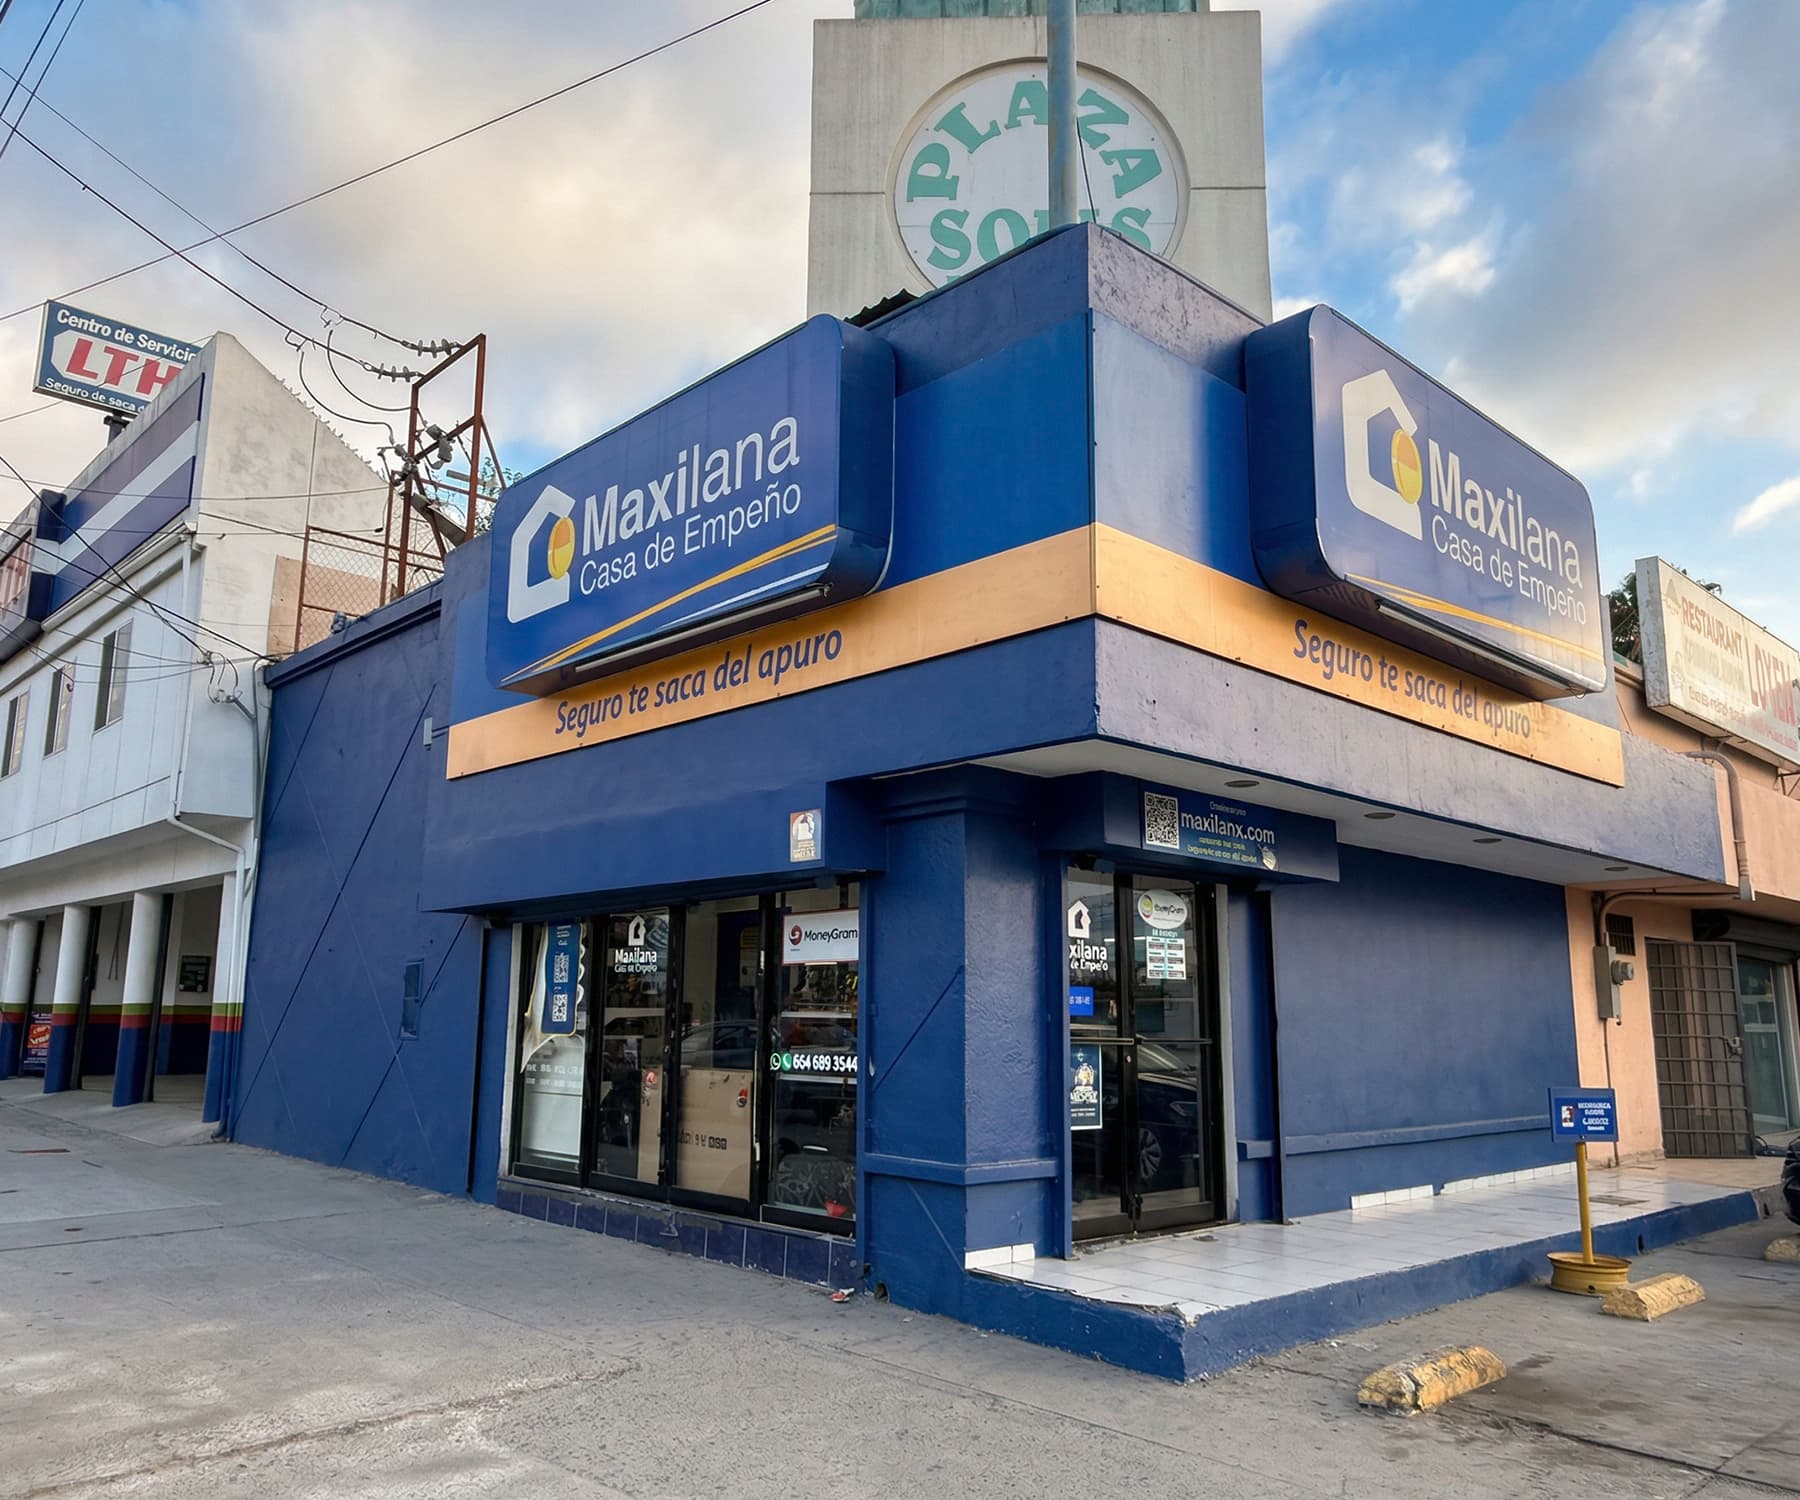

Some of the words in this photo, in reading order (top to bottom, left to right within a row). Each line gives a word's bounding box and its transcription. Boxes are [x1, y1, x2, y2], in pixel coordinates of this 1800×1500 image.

[906, 80, 1162, 202] PLAZA
[927, 207, 1152, 270] SOS
[57, 309, 111, 337] Centro
[114, 327, 135, 344] de
[66, 337, 182, 396] LTH
[45, 377, 89, 399] Seguro
[91, 390, 106, 403] de
[108, 397, 135, 412] saca
[582, 416, 800, 556] Maxilana
[1427, 438, 1584, 589] Maxilana
[579, 554, 637, 596] Casa
[644, 531, 675, 575] de
[684, 481, 802, 555] Empeño
[1431, 514, 1485, 575] Casa
[1489, 547, 1513, 588] de
[1519, 560, 1587, 626] Empeño
[1681, 596, 1743, 660] RESTAURANT
[555, 692, 622, 738] Seguro
[628, 683, 649, 713] te
[654, 667, 705, 708] saca
[713, 643, 752, 690] del
[758, 629, 843, 686] apuro
[1293, 618, 1374, 682] Seguro
[1378, 655, 1398, 691] te
[1404, 669, 1447, 710] saca
[1452, 687, 1478, 721] del
[1483, 702, 1531, 740] apuro
[804, 928, 858, 943] MoneyGram
[812, 1055, 832, 1071] 689
[832, 1056, 858, 1072] 3544
